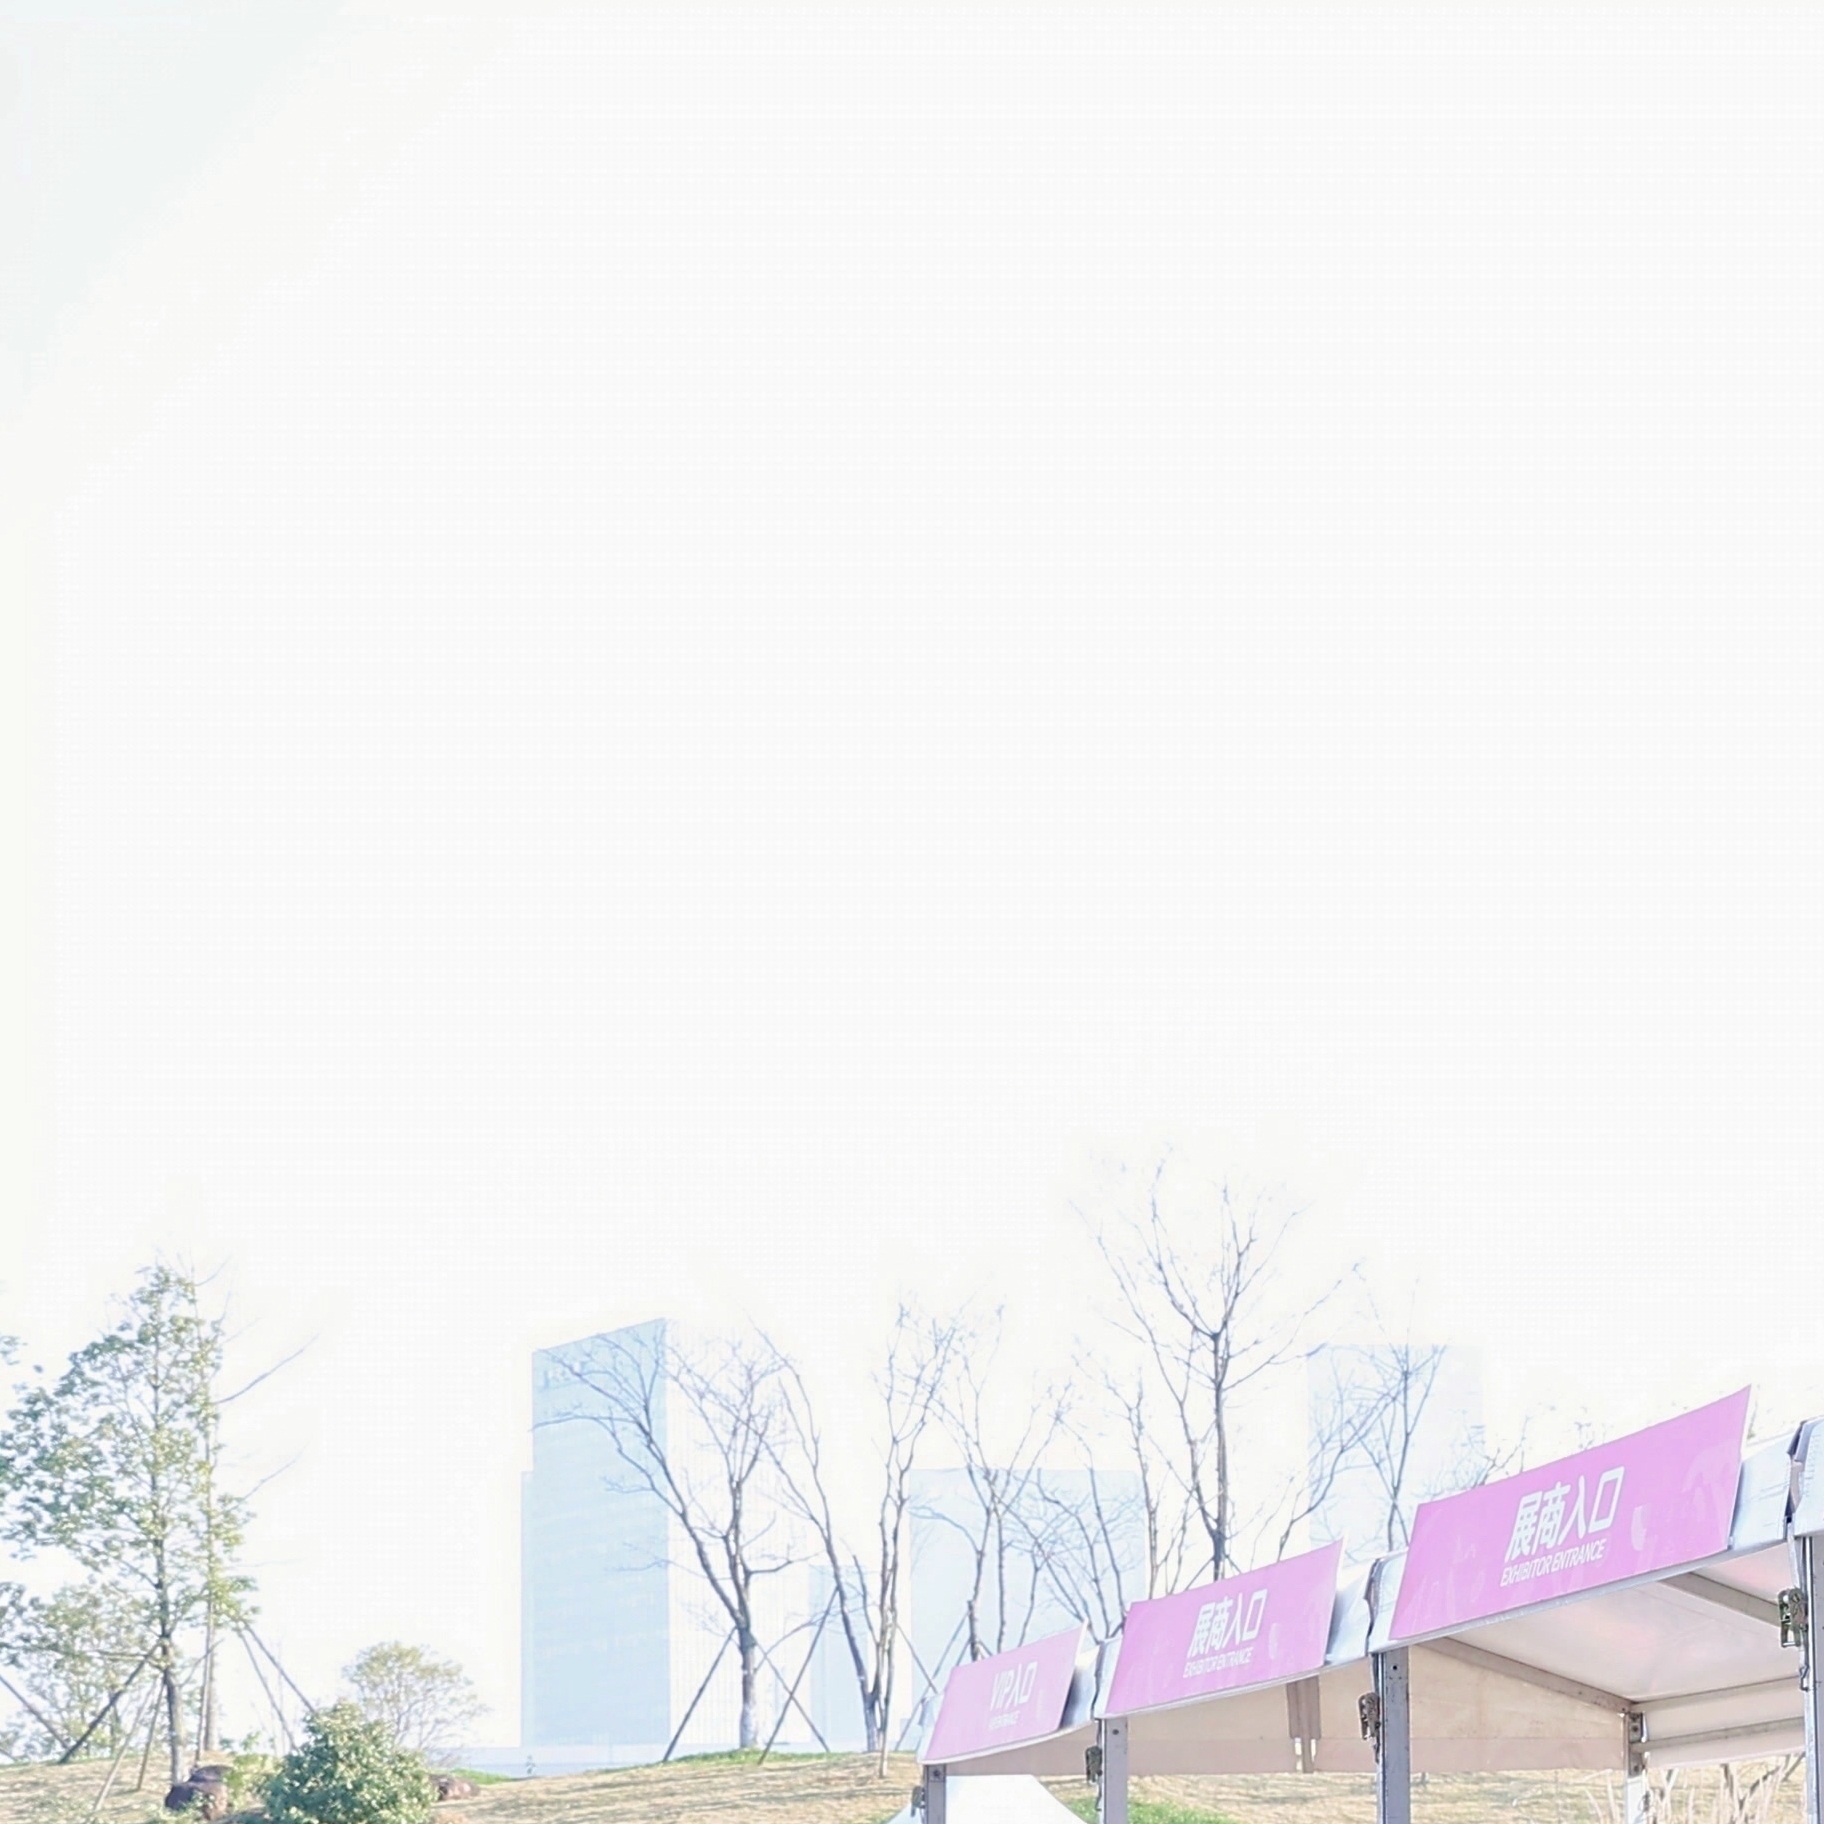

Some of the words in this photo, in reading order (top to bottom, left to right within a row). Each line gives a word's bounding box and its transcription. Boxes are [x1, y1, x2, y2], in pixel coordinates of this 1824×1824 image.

[1505, 1466, 1626, 1561] 展商入口
[1499, 1553, 1552, 1586] EXHIBITOR
[1552, 1538, 1607, 1574] ENTRANCE
[1186, 1588, 1269, 1657] 展商入口
